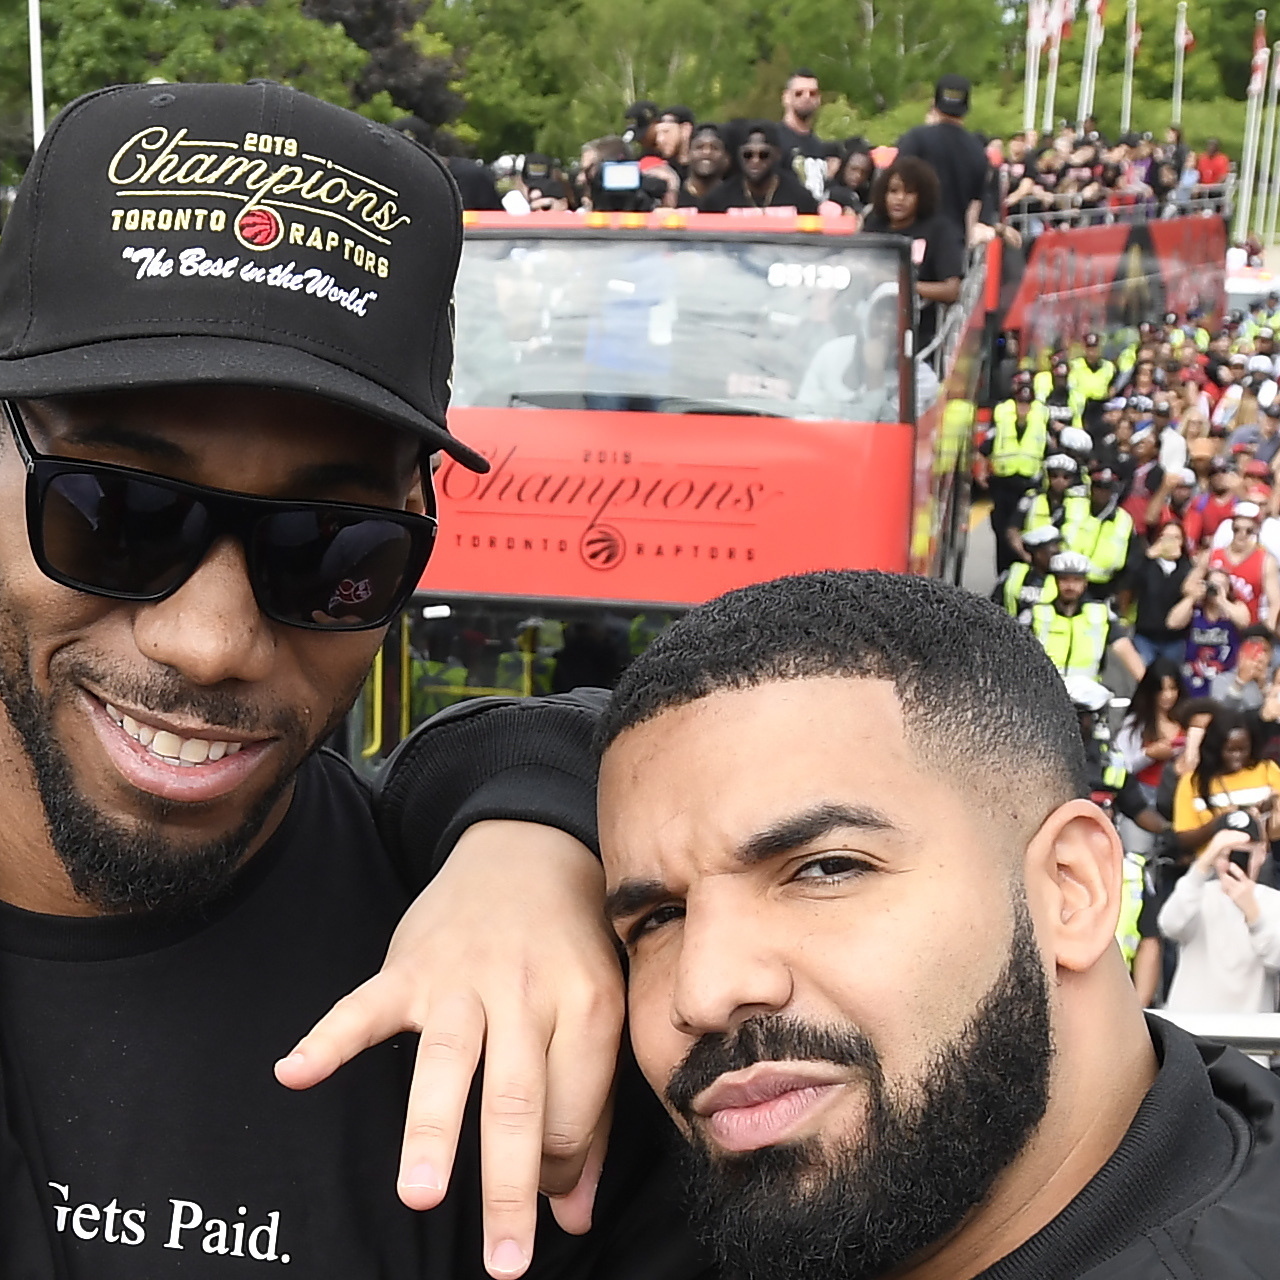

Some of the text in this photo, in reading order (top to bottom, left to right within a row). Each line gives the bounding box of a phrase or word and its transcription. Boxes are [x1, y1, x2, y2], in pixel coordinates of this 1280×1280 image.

[108, 126, 411, 231] Champions
[243, 133, 298, 157] 2019
[111, 208, 390, 278] TORONTO RAPTORS
[122, 247, 377, 317] "The Best in the World"
[442, 444, 784, 513] Champions
[456, 534, 756, 562] TORONTO RAPTORS
[163, 1197, 291, 1264] Paid.
